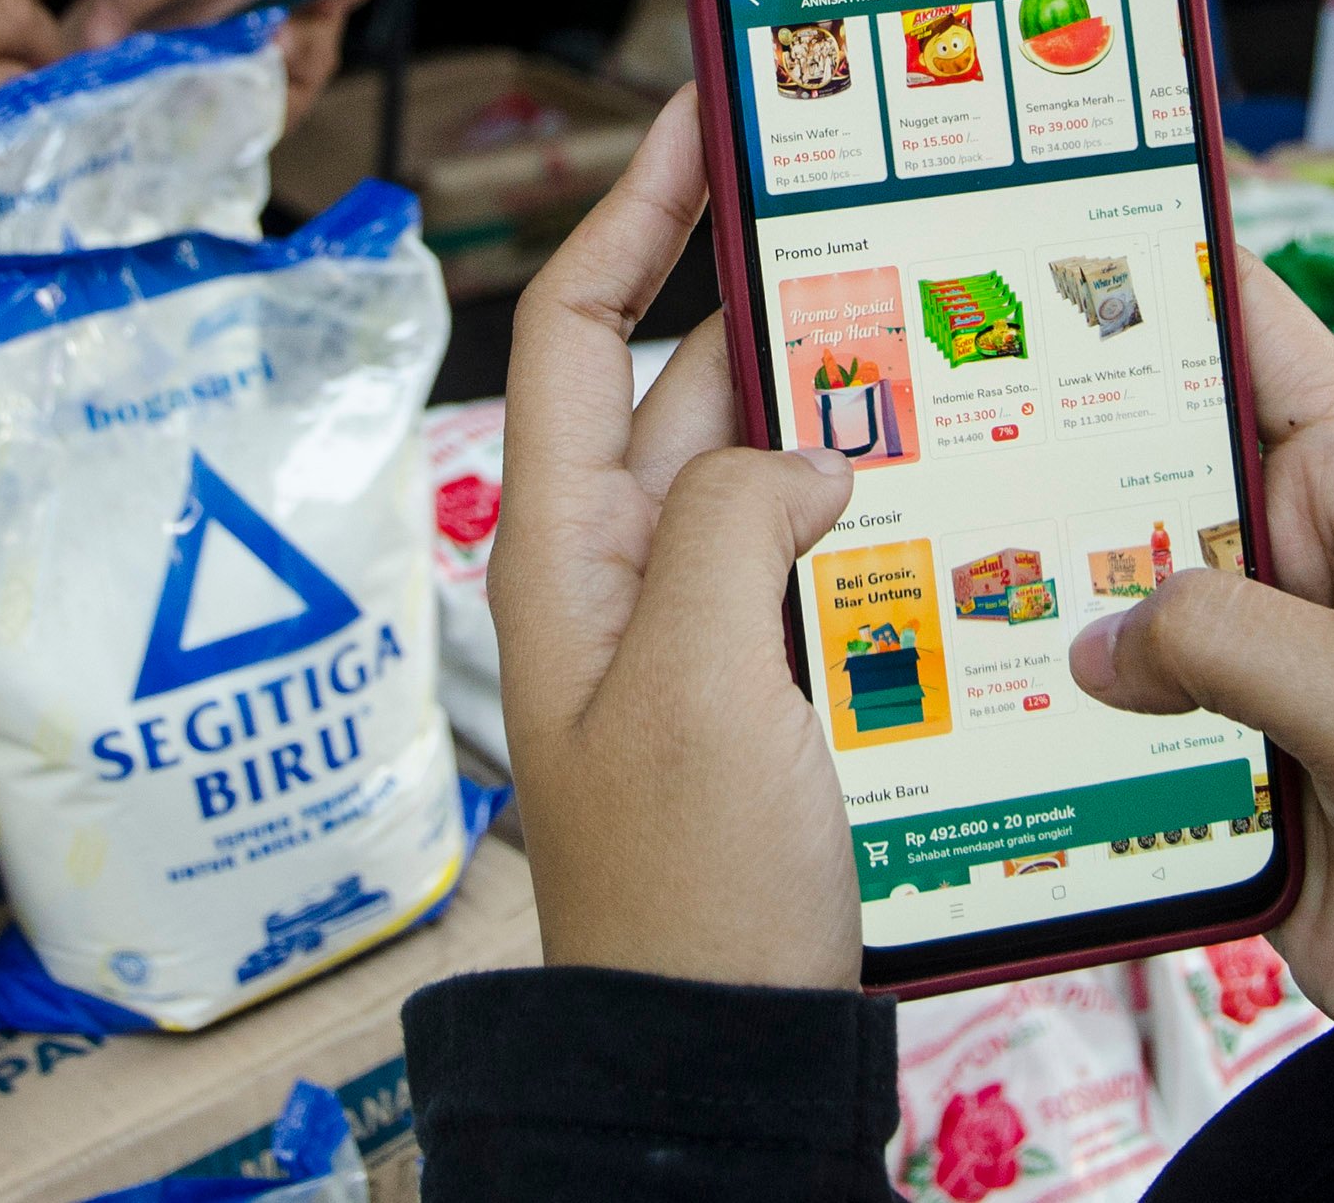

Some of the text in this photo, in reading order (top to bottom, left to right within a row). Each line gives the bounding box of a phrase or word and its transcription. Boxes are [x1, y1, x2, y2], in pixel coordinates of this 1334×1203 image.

[1150, 87, 1173, 98] ABC
[1026, 95, 1114, 113] Semangka Merah
[900, 113, 970, 129] Nugget ayam
[1152, 109, 1168, 120] Rp
[771, 127, 839, 144] Nissin Wafer
[1029, 117, 1114, 136] Rp 39.000 /pcs
[1155, 130, 1168, 140] Rp
[902, 139, 919, 152] Rp
[923, 133, 964, 148] 15.500
[1031, 146, 1045, 156] Rp
[1047, 140, 1081, 152] 34.000
[774, 147, 862, 168] Rp 49.500 /pcs
[905, 161, 919, 171] Rp
[922, 155, 956, 168] 13.300
[776, 177, 790, 187] Rp
[793, 171, 828, 184] 41.500
[1089, 203, 1163, 221] Lihat Semua
[775, 239, 869, 261] Promo Jumat
[790, 298, 894, 325] Promo Spesial
[809, 322, 880, 346] Tiap Hari
[1181, 359, 1207, 369] Rose
[1059, 370, 1092, 387] Luwak
[1095, 368, 1127, 382] White
[1184, 380, 1200, 391] Rp
[933, 391, 974, 405] Indomie
[977, 387, 1003, 399] Rasa
[1061, 399, 1077, 410] Rp
[1081, 391, 1121, 405] 12.900
[1187, 401, 1200, 411] Rp
[935, 416, 952, 427] Rp
[956, 409, 996, 424] 13.300
[1063, 419, 1077, 430] Rp
[1080, 413, 1113, 426] 11.300
[938, 432, 984, 447] Rp 14.400
[998, 427, 1014, 437] 7%
[1120, 469, 1194, 488] Lihat Semua
[859, 510, 902, 527] Grosir
[837, 568, 916, 591] Beli Grosir,
[834, 586, 922, 610] Biar Untung
[965, 654, 1050, 676] Sarimi isi 2 Kuah
[967, 686, 983, 698] Rp
[987, 679, 1028, 694] 70.900
[91, 623, 402, 782] SEGITIGA
[969, 702, 1015, 717] Rp 81.000
[1027, 695, 1048, 707] 12%
[1151, 733, 1224, 754] Lihat Semua
[193, 715, 361, 821] BIRU
[843, 783, 929, 806] Produk Baru
[905, 805, 1076, 847] Rp 492.600 20 produk
[907, 825, 1073, 864] Sahabat mendapat gratis ongkir!
